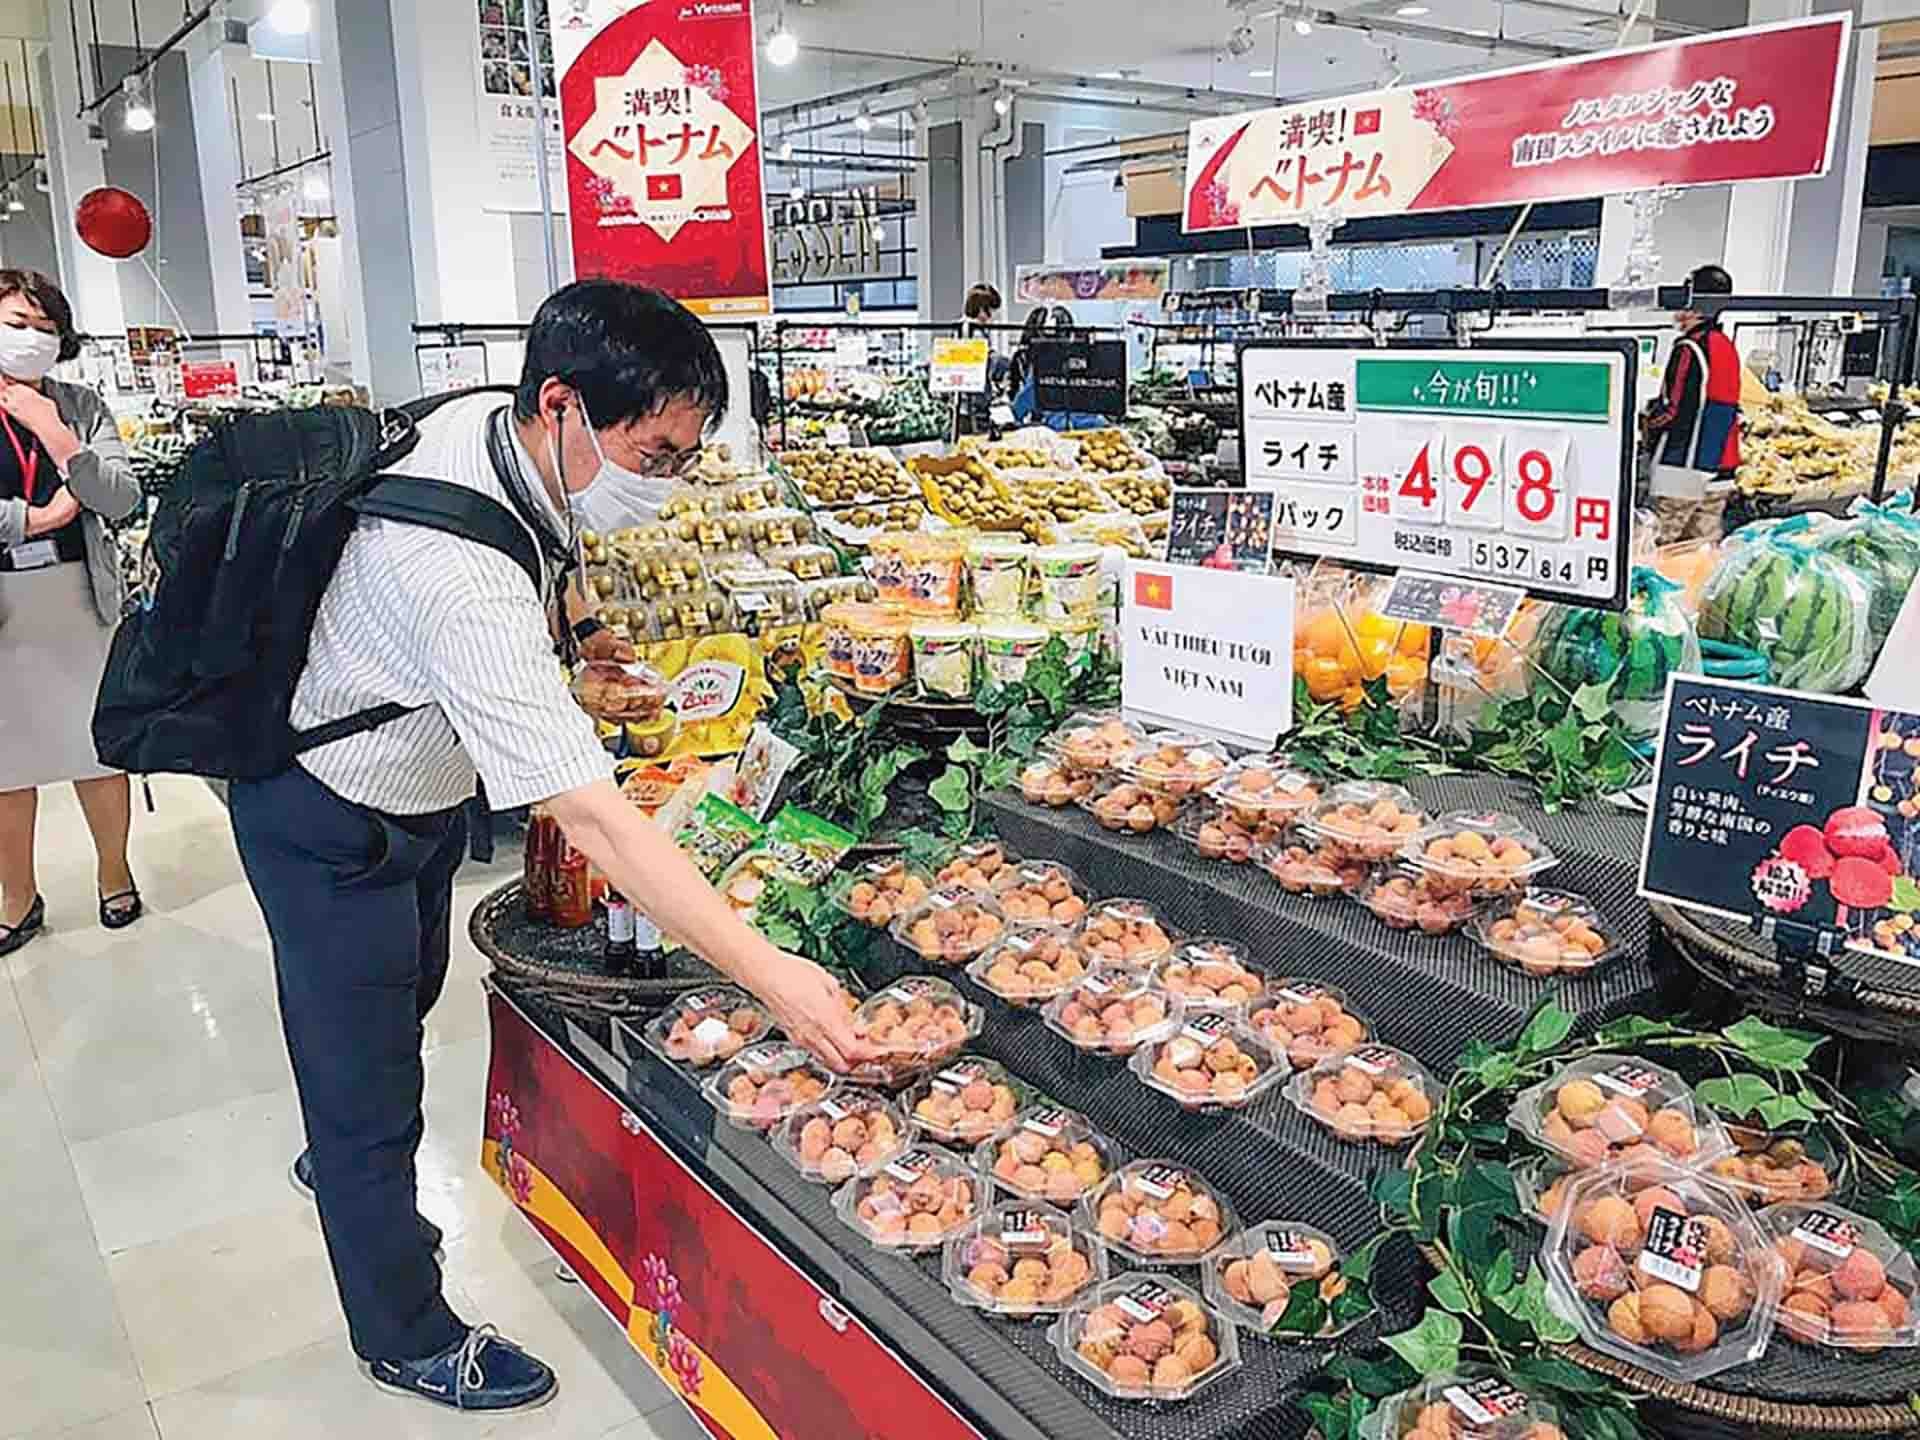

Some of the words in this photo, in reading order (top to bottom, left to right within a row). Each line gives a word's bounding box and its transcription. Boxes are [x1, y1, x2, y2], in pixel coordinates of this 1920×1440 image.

[625, 87, 691, 116] 満喫!
[1565, 79, 1734, 126] ノスタルジックな
[589, 123, 734, 166] ベトナム
[1279, 108, 1347, 150] 満喫!
[1514, 109, 1773, 164] 南国スタイルに癒されよう
[1249, 152, 1392, 208] ベトナム
[1255, 379, 1346, 412] ベトナム産
[1427, 369, 1520, 406] 今が旬!!
[1262, 440, 1339, 471] ライチ
[1399, 444, 1555, 522] 498
[1394, 531, 1452, 557] 税込価格
[1587, 556, 1609, 581] 円
[1204, 674, 1243, 698] NAM
[1684, 697, 1791, 731] ベトナム産
[1676, 723, 1820, 784] ライチ
